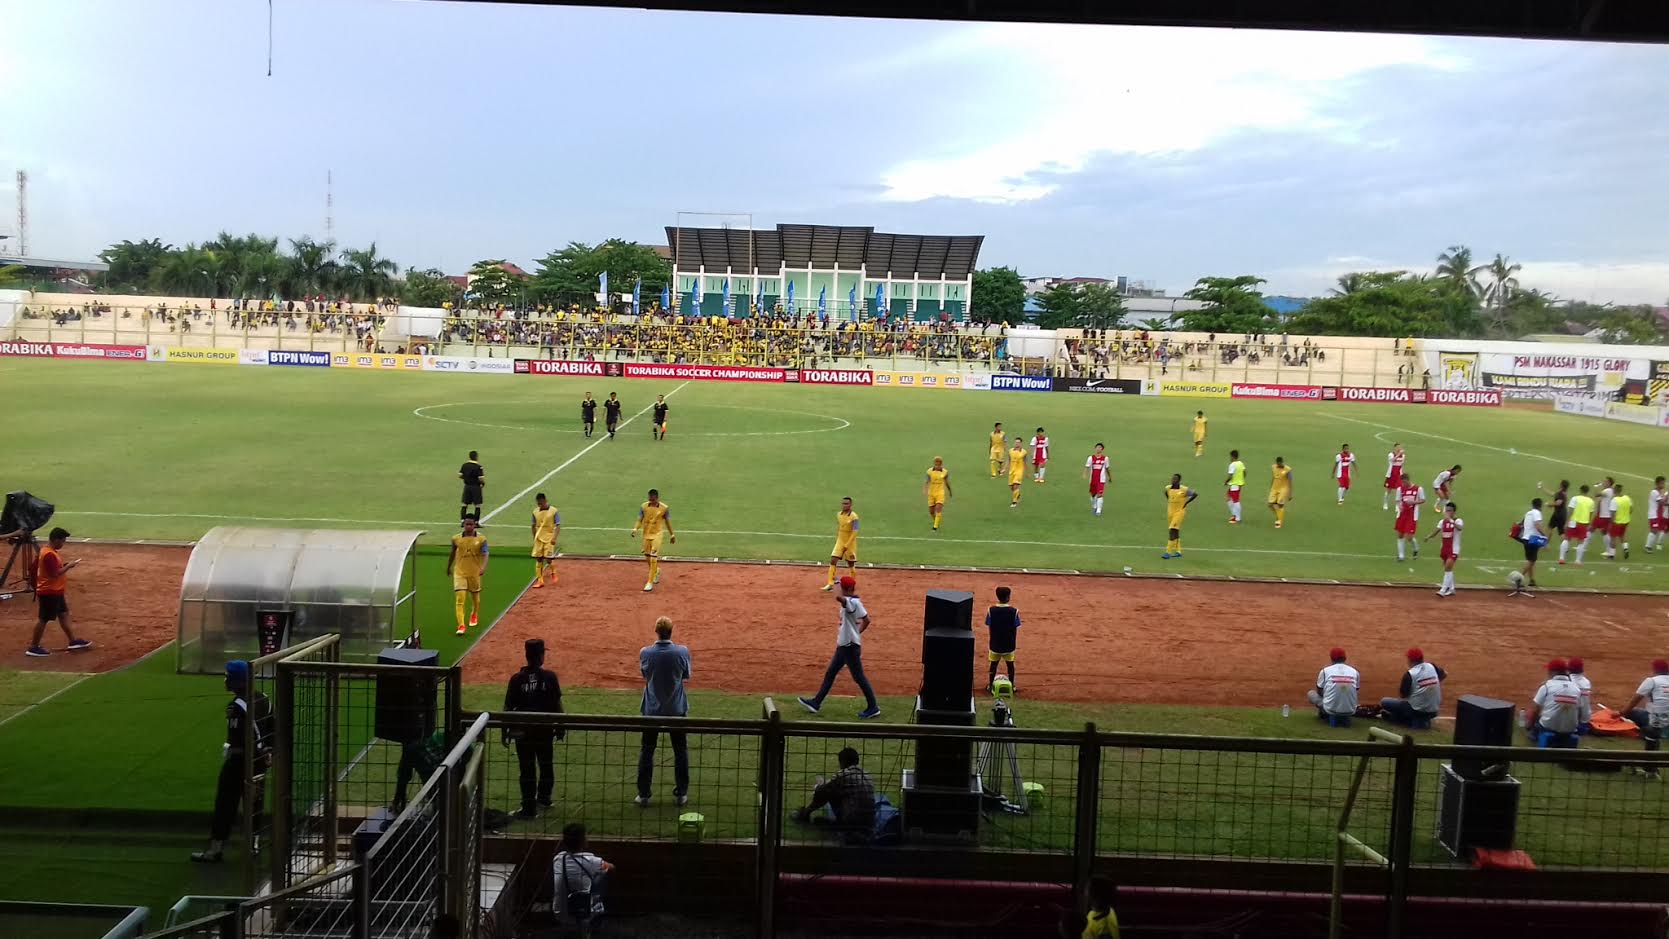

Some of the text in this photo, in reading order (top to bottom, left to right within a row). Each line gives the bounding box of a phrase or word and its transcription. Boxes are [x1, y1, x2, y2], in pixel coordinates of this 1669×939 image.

[0, 344, 53, 355] RABIKA
[270, 352, 299, 363] BTPN
[300, 354, 329, 364] Wow!
[1514, 356, 1631, 371] PSM MAKASSAR 1915 GLORY
[533, 362, 602, 374] TORABIKA
[627, 367, 675, 376] TORABIKA
[676, 368, 711, 376] SOCCER
[712, 368, 783, 379] CHAMPIONSHIP
[803, 371, 871, 383] TORABIKA
[993, 377, 1050, 388] BTPN Wow!
[1341, 388, 1408, 400] TORABIKA
[1431, 392, 1499, 403] TORABIKA
